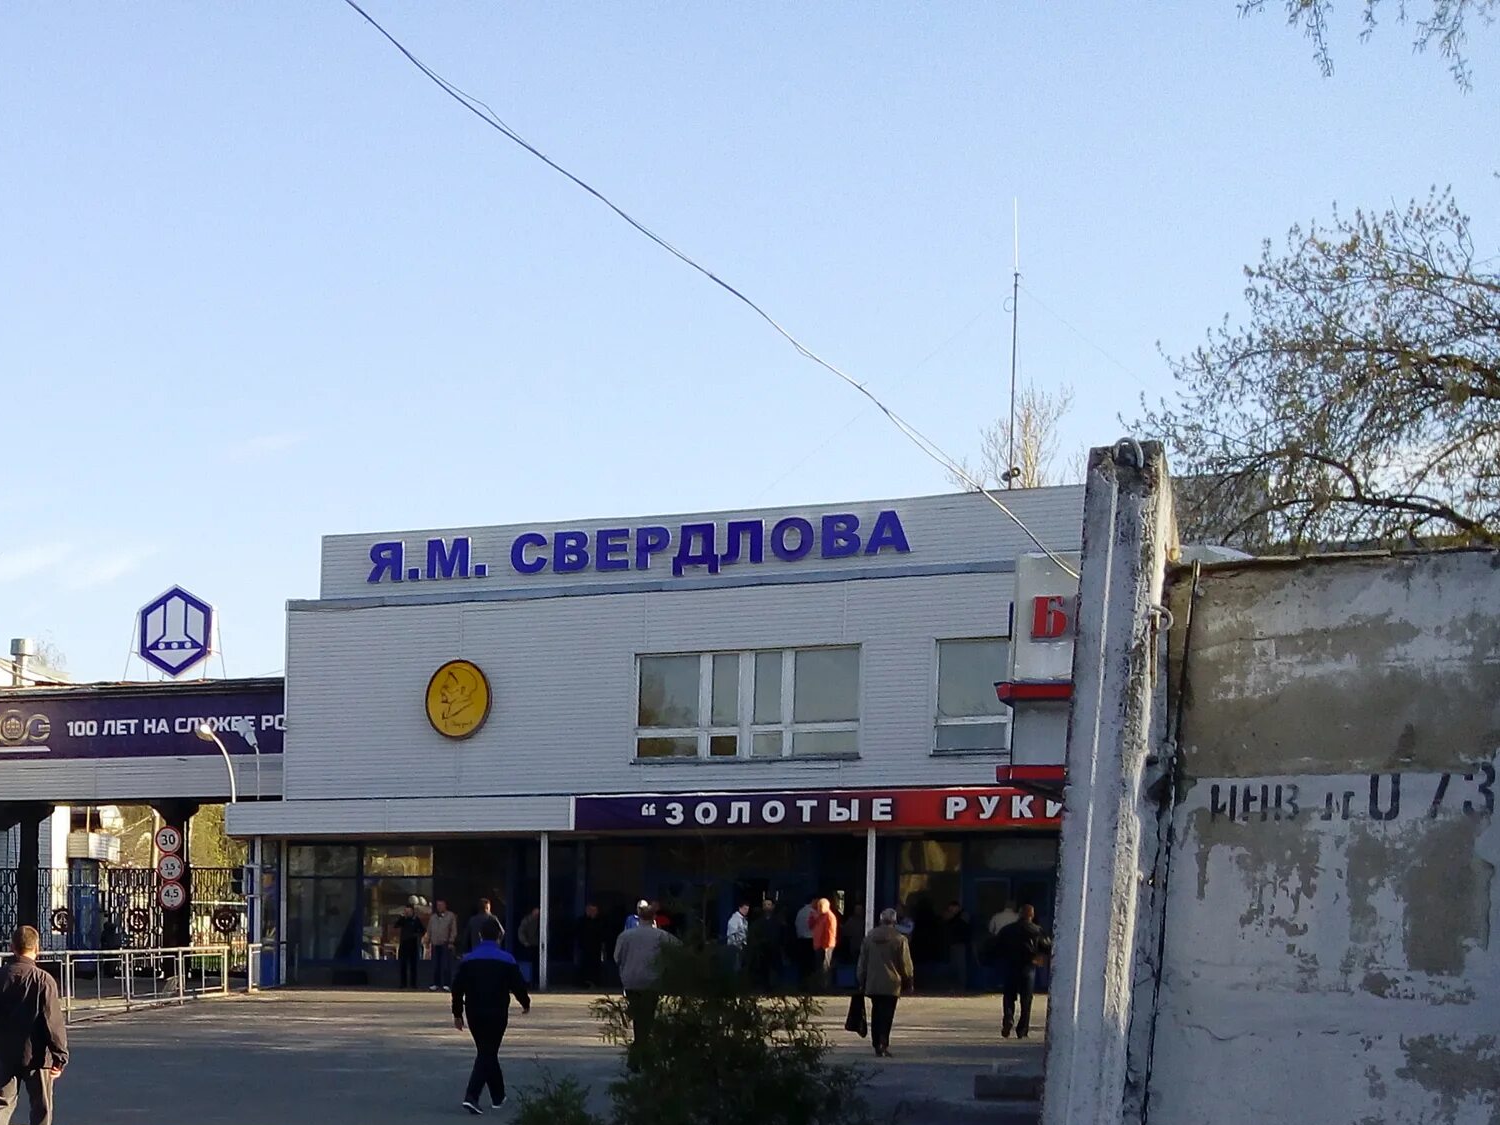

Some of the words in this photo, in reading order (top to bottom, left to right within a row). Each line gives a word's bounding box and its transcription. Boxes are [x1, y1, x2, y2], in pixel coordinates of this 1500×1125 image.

[367, 536, 488, 583] Я.М.
[510, 510, 911, 576] СВЕРДЛОВА
[67, 720, 98, 737] 100
[102, 719, 139, 735] ЛЕТ
[143, 718, 170, 734] НА
[161, 834, 176, 846] 30
